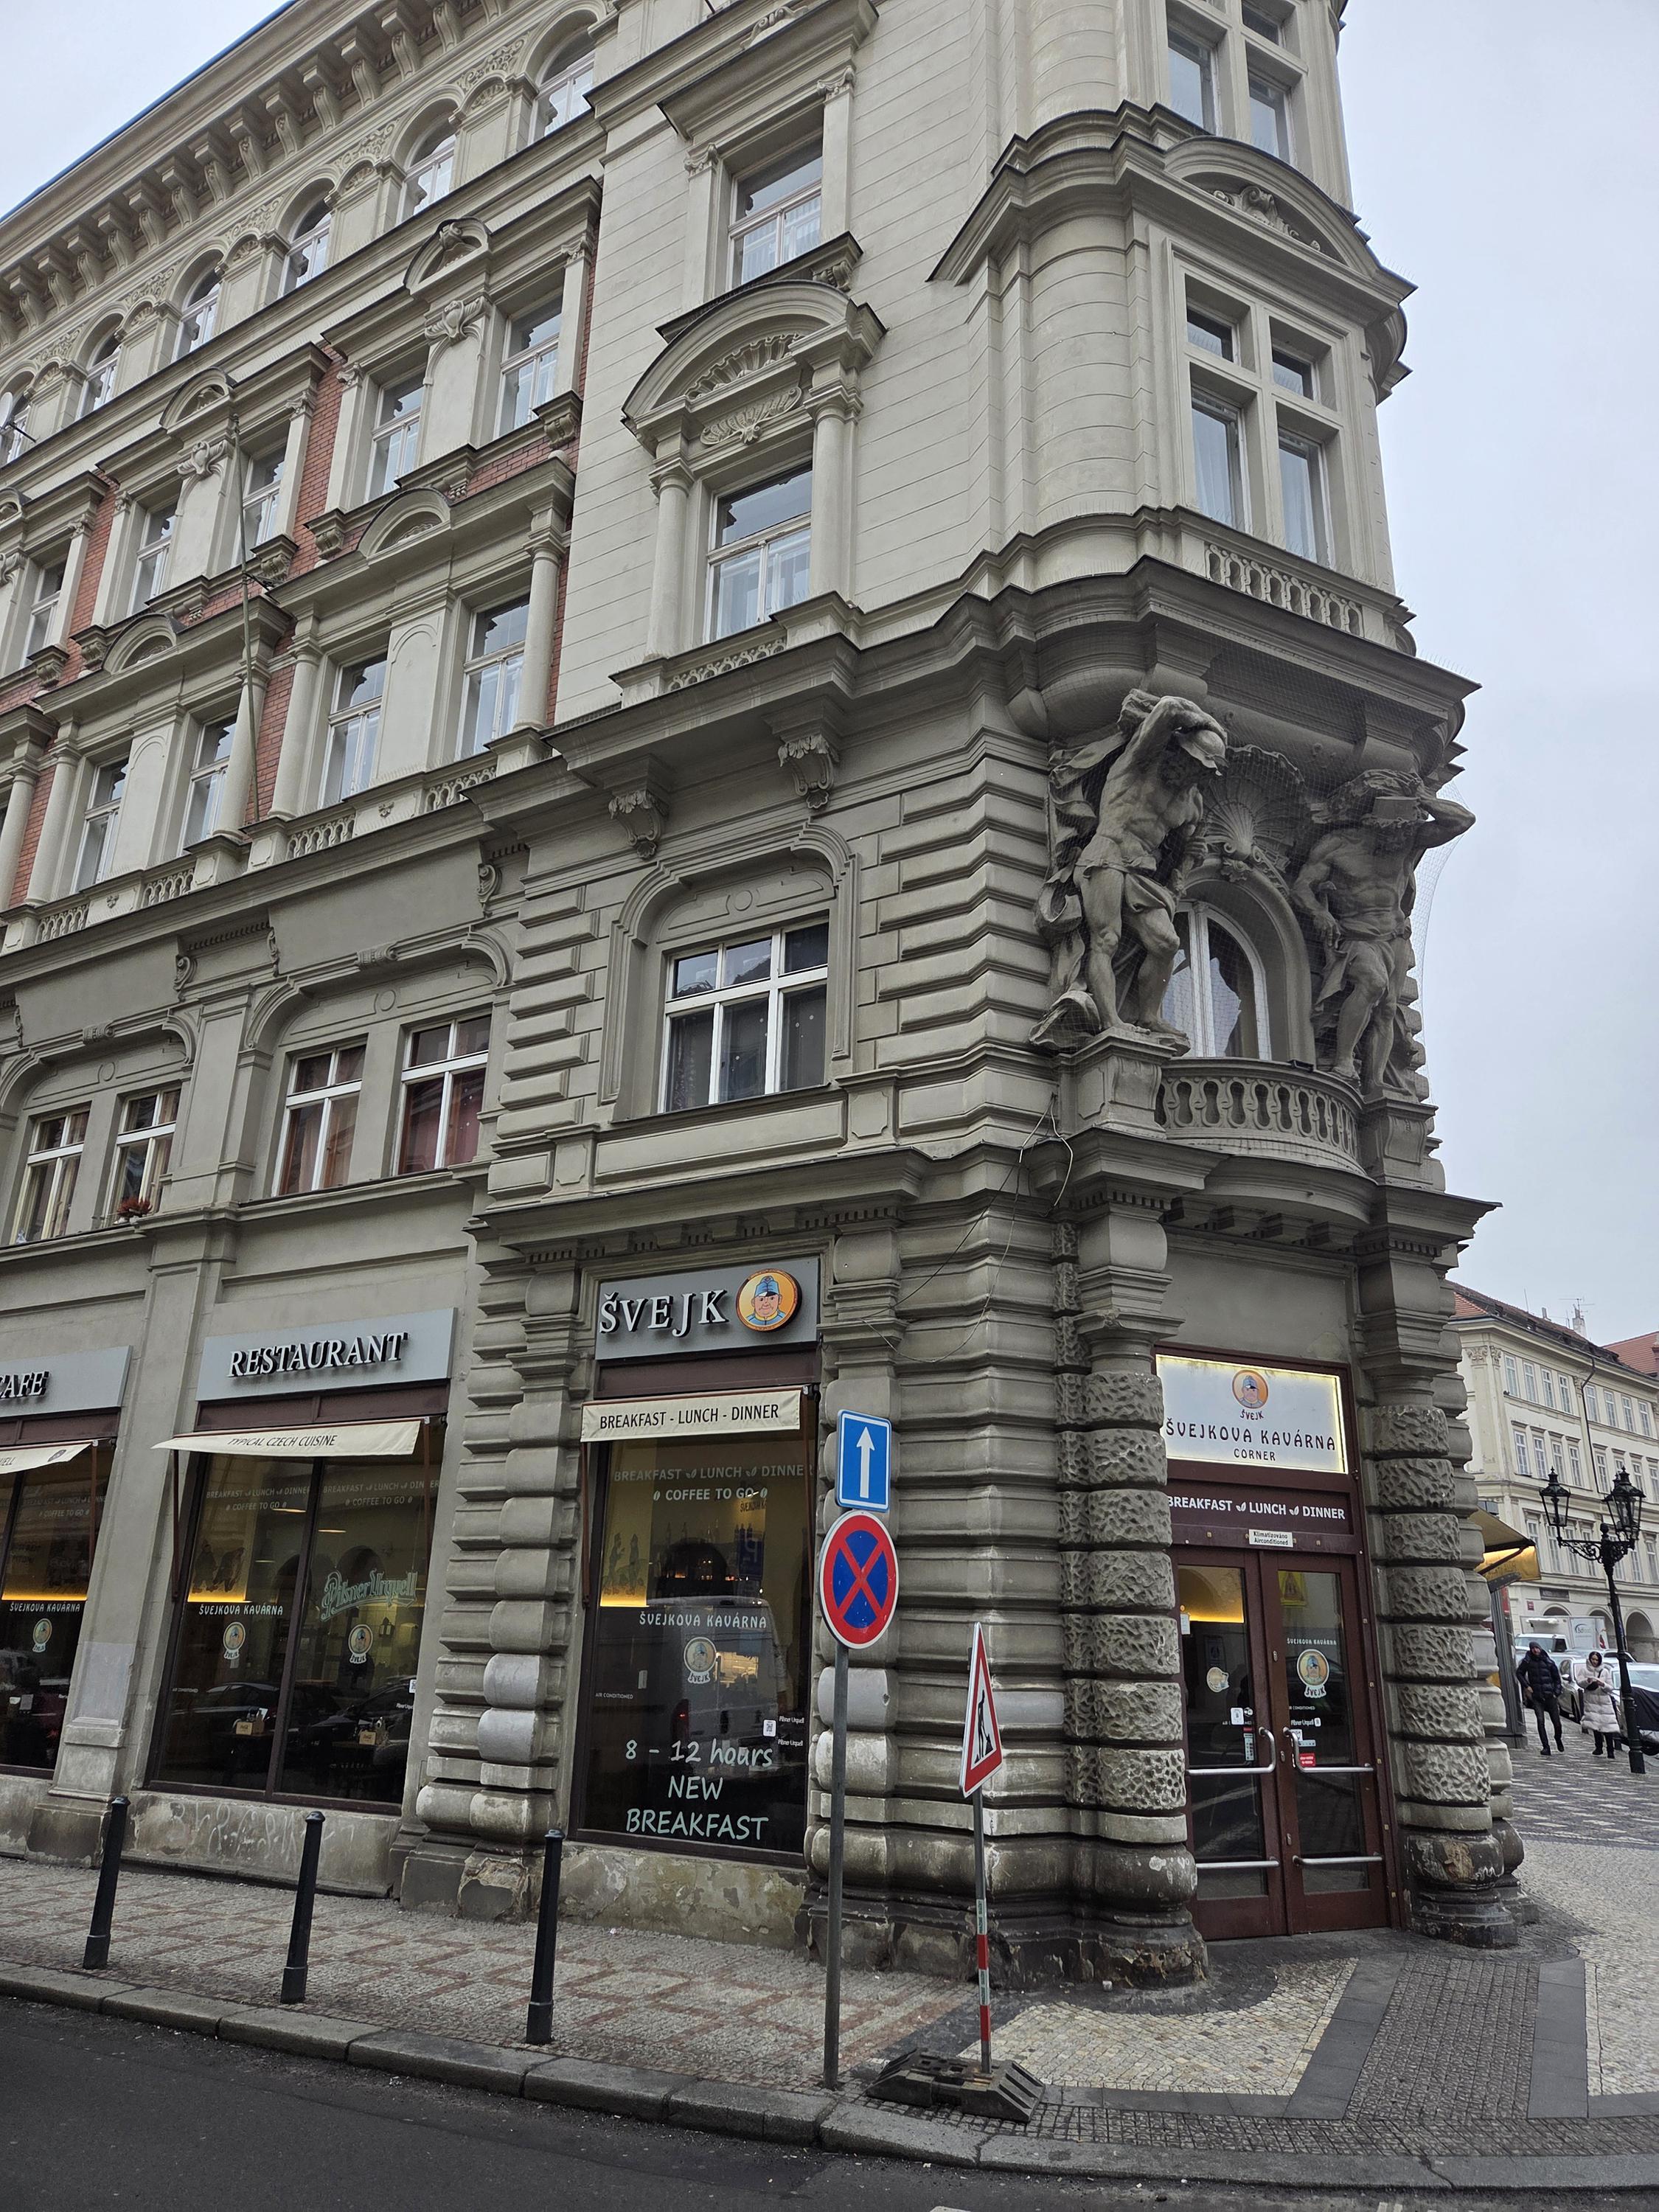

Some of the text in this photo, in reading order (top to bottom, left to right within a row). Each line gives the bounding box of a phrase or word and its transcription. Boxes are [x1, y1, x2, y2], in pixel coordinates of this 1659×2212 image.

[599, 1290, 728, 1338] ŠVEJK
[227, 1332, 408, 1377] RESTAURANT
[600, 1412, 667, 1429] BREAKFAST
[678, 1408, 718, 1424] LUNCH
[731, 1404, 779, 1420] DINNER
[1240, 1409, 1264, 1420] ŠVEJK
[1166, 1417, 1335, 1450] ŠVEJKOVA KAVÁRNA
[227, 1435, 338, 1447] TYPICAL CZECH CUISINE
[1234, 1448, 1276, 1461] CORNER
[614, 1469, 682, 1481] BREAKFAST
[700, 1467, 742, 1478] LUNCH
[206, 1490, 243, 1498] BREAKFAST
[252, 1488, 274, 1496] LUNCH
[323, 1480, 439, 1493] BREAKFAST LUNCH DINER
[666, 1487, 754, 1500] COFFEE TO GO
[232, 1503, 257, 1511] COFFEE
[270, 1501, 279, 1509] GO
[352, 1496, 405, 1506] COFFEE TO GO
[1249, 1502, 1286, 1515] LUNCH
[1303, 1506, 1345, 1520] DINNER
[321, 1568, 418, 1621] Pilsner Urquell
[10, 1601, 80, 1613] ŠVEJKOVA KAVÁRNA
[199, 1602, 283, 1615] ŠVEJKOVA KAVÁRNA
[639, 1611, 767, 1628] ŠVEJKOVA KAVÁRNA
[1306, 1687, 1325, 1696] ŠVEJK
[625, 1740, 637, 1759] 8
[670, 1740, 701, 1763] 12
[710, 1738, 773, 1767] hours
[668, 1775, 723, 1801] NEW
[627, 1808, 769, 1840] BREAKFAST
